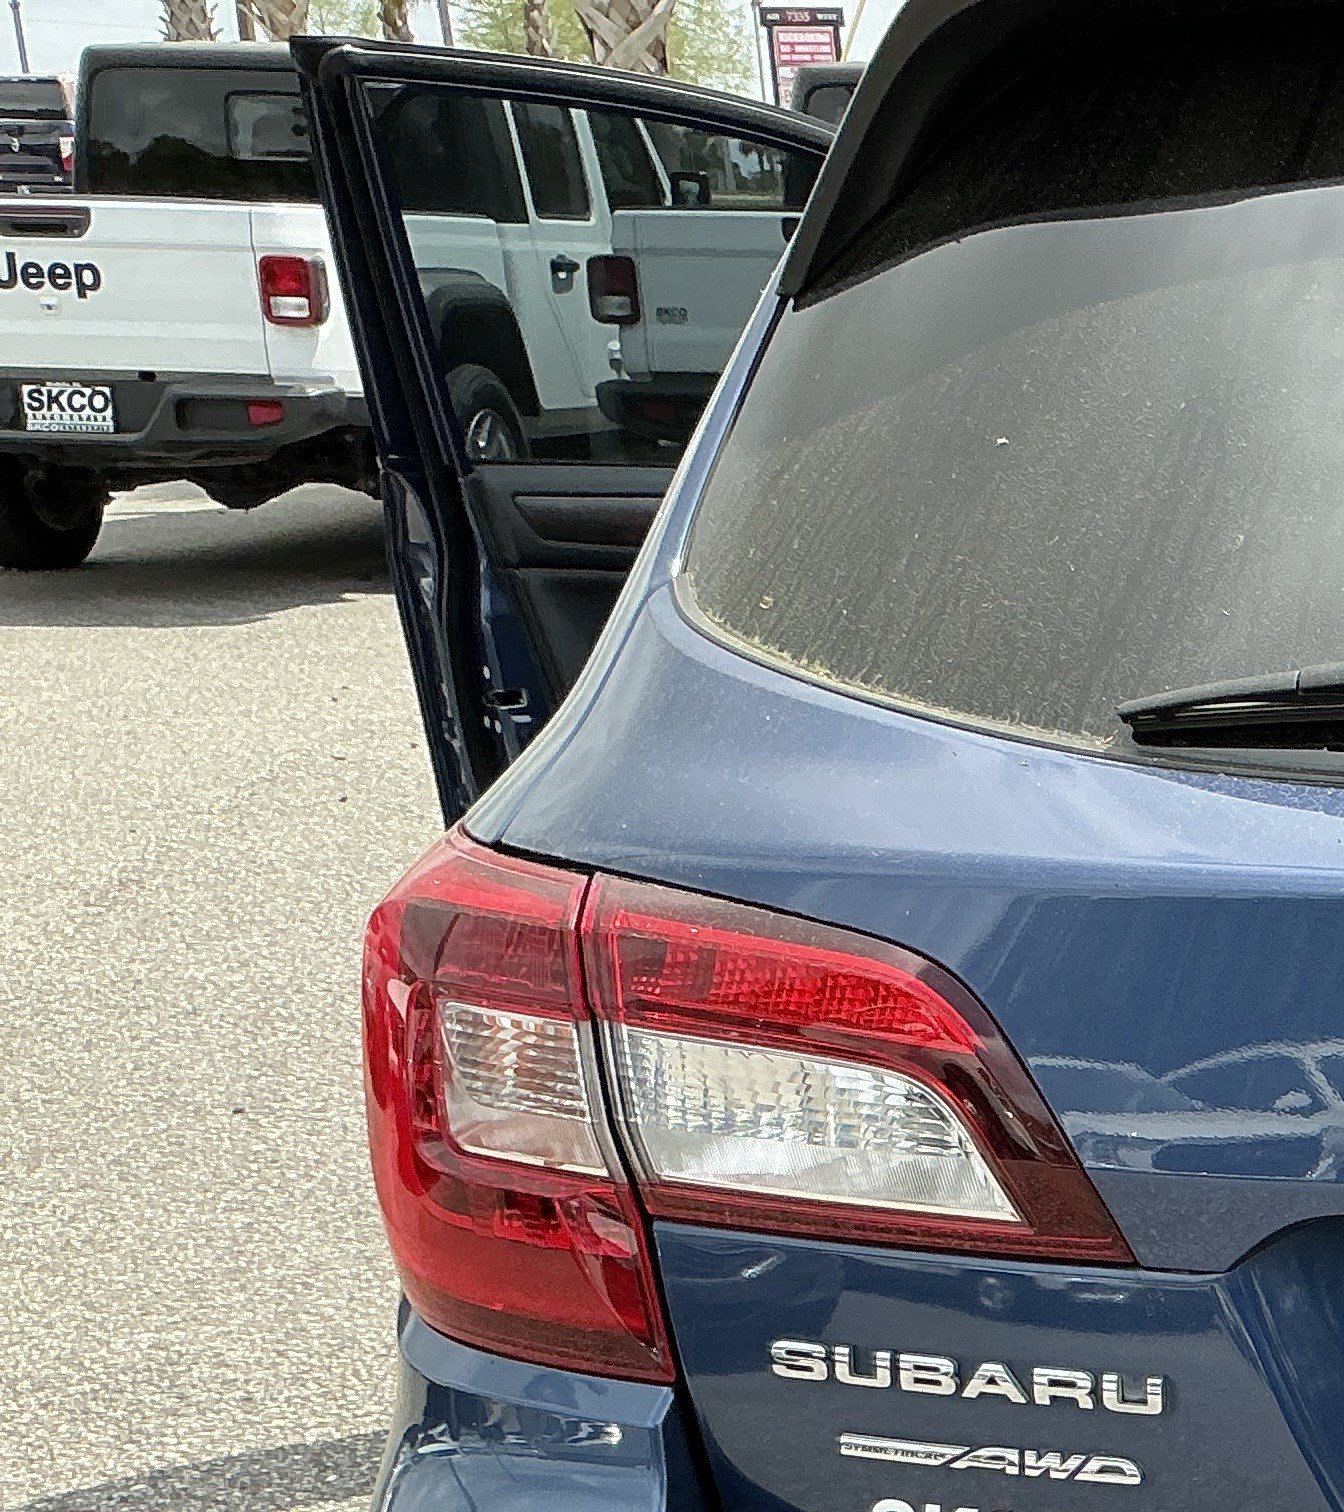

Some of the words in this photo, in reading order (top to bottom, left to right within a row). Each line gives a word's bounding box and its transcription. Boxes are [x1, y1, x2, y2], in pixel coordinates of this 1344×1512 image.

[0, 251, 102, 299] Jeep
[26, 388, 111, 413] SKCO
[769, 1336, 1166, 1416] SUBARU
[949, 1446, 1143, 1486] AWD
